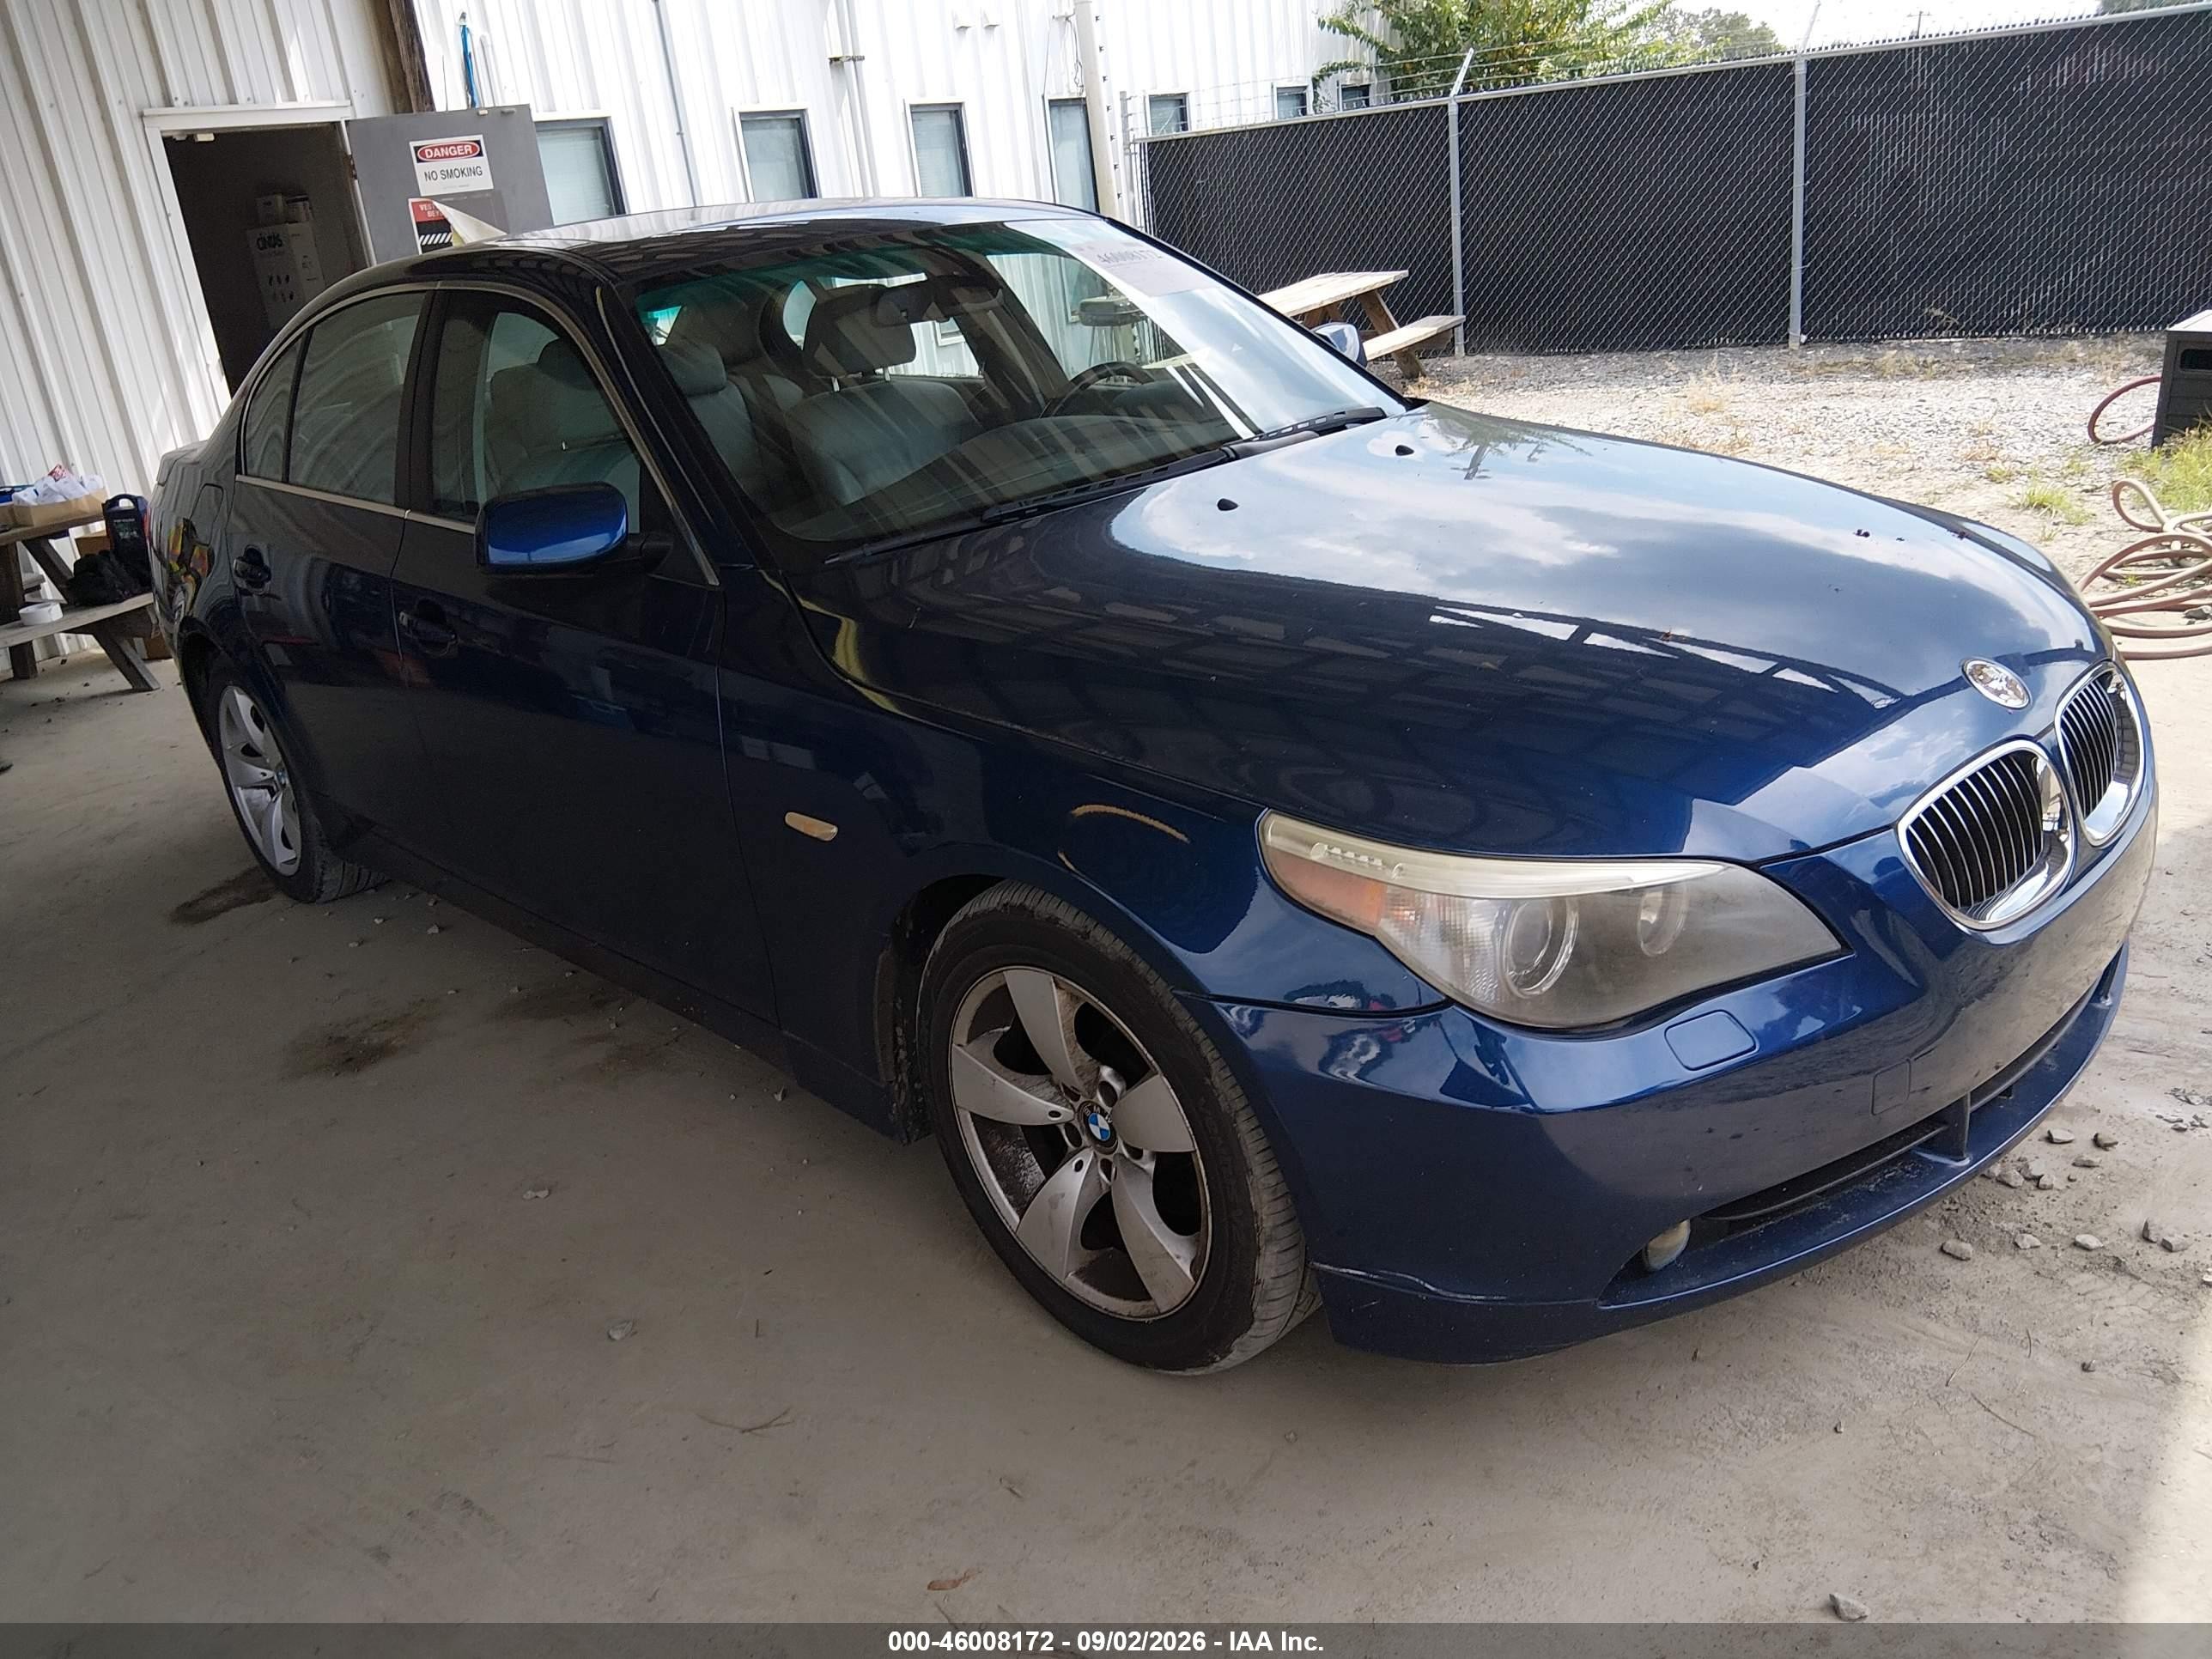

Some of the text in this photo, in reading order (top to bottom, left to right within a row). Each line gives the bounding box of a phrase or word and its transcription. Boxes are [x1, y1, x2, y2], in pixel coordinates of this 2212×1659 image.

[425, 144, 472, 159] DANGER
[424, 166, 483, 182] NO SMOKING
